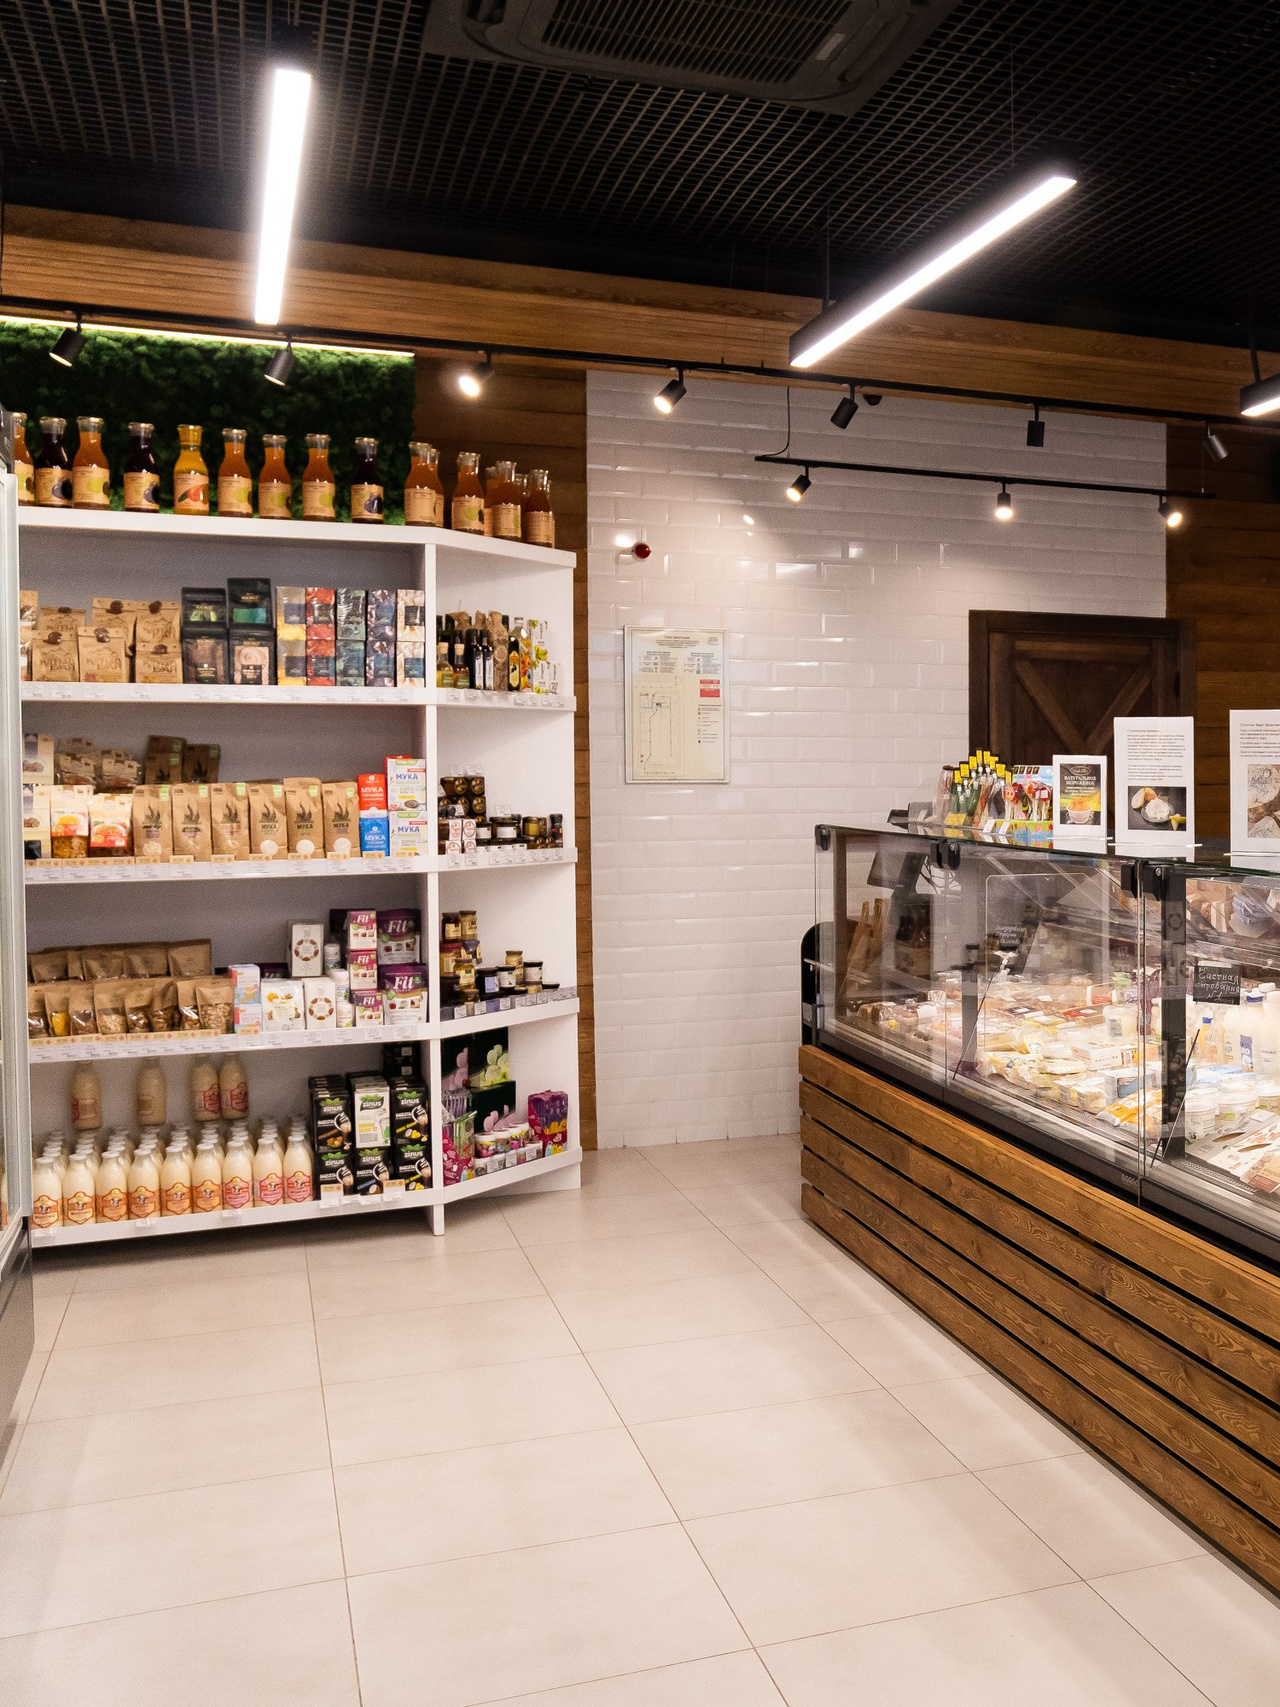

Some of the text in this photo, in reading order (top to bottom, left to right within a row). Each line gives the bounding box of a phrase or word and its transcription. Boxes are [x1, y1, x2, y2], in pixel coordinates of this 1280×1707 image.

[356, 914, 370, 924] Fit
[387, 920, 408, 933] Fit
[356, 955, 370, 964] Fit
[393, 976, 414, 990] Fit
[362, 996, 376, 1006] Fit
